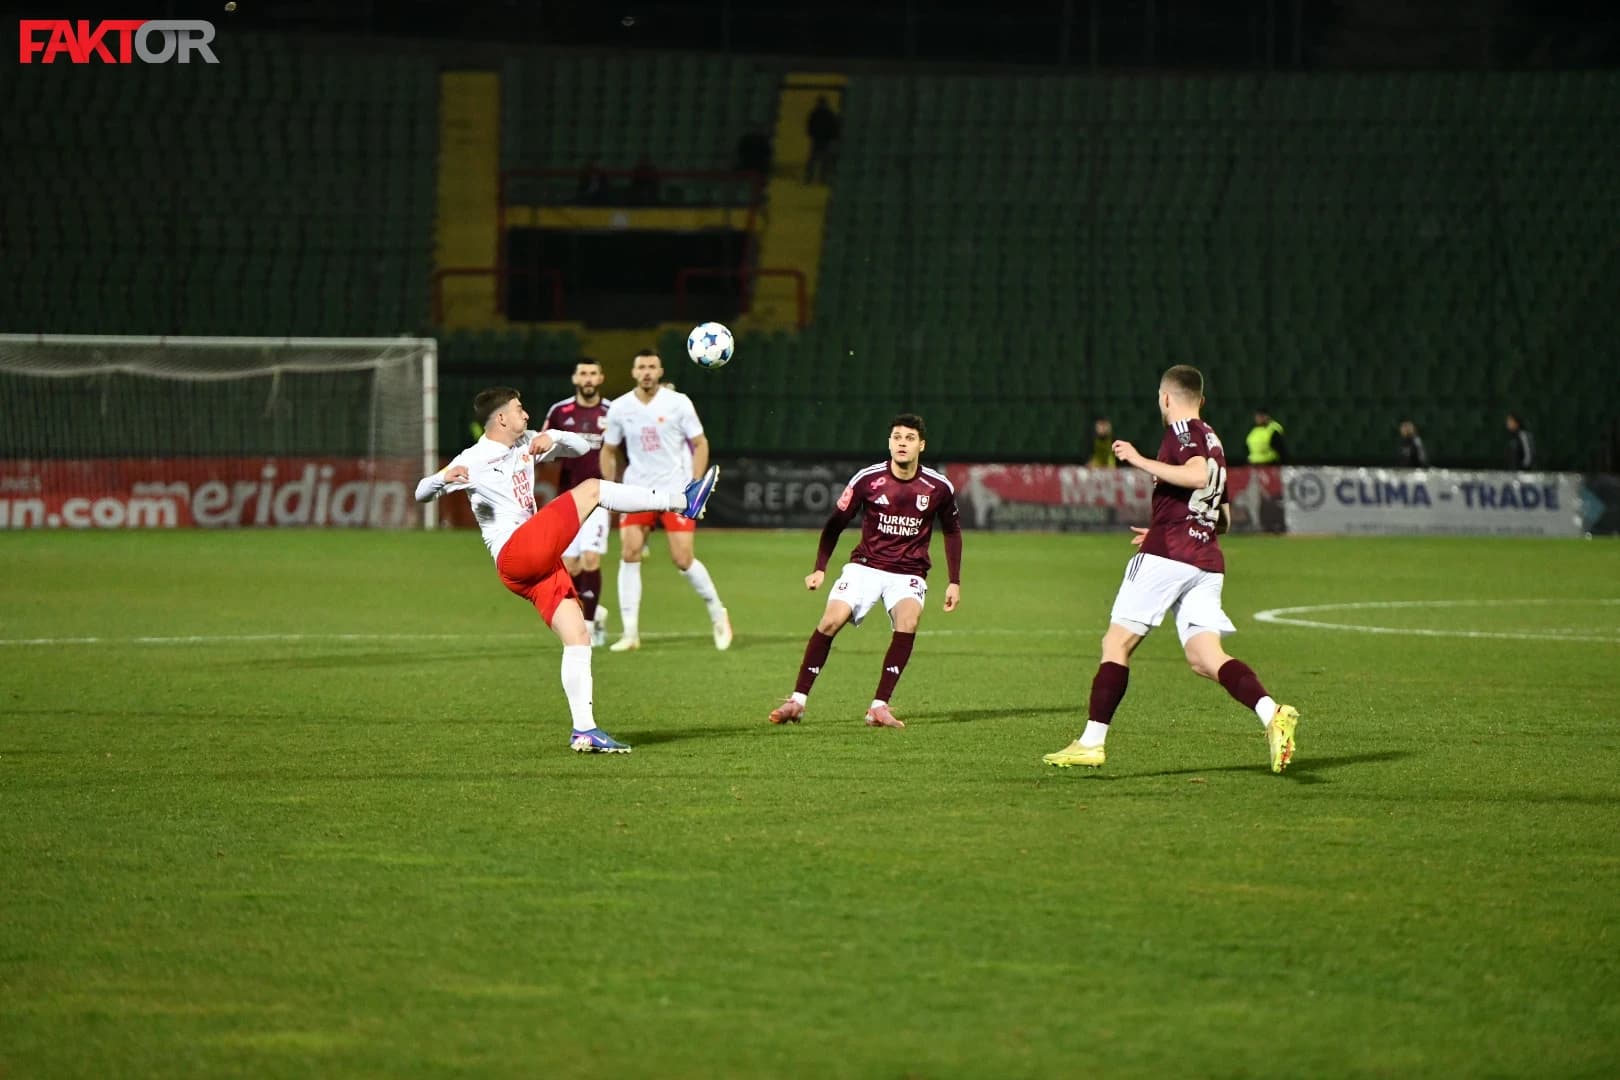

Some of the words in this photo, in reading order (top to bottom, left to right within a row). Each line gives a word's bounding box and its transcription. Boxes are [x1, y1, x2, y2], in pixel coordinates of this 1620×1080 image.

[1335, 478, 1432, 508] CLIMA
[1460, 480, 1560, 511] TRADE
[878, 512, 924, 527] TURKISH
[877, 523, 920, 537] AIRLINES
